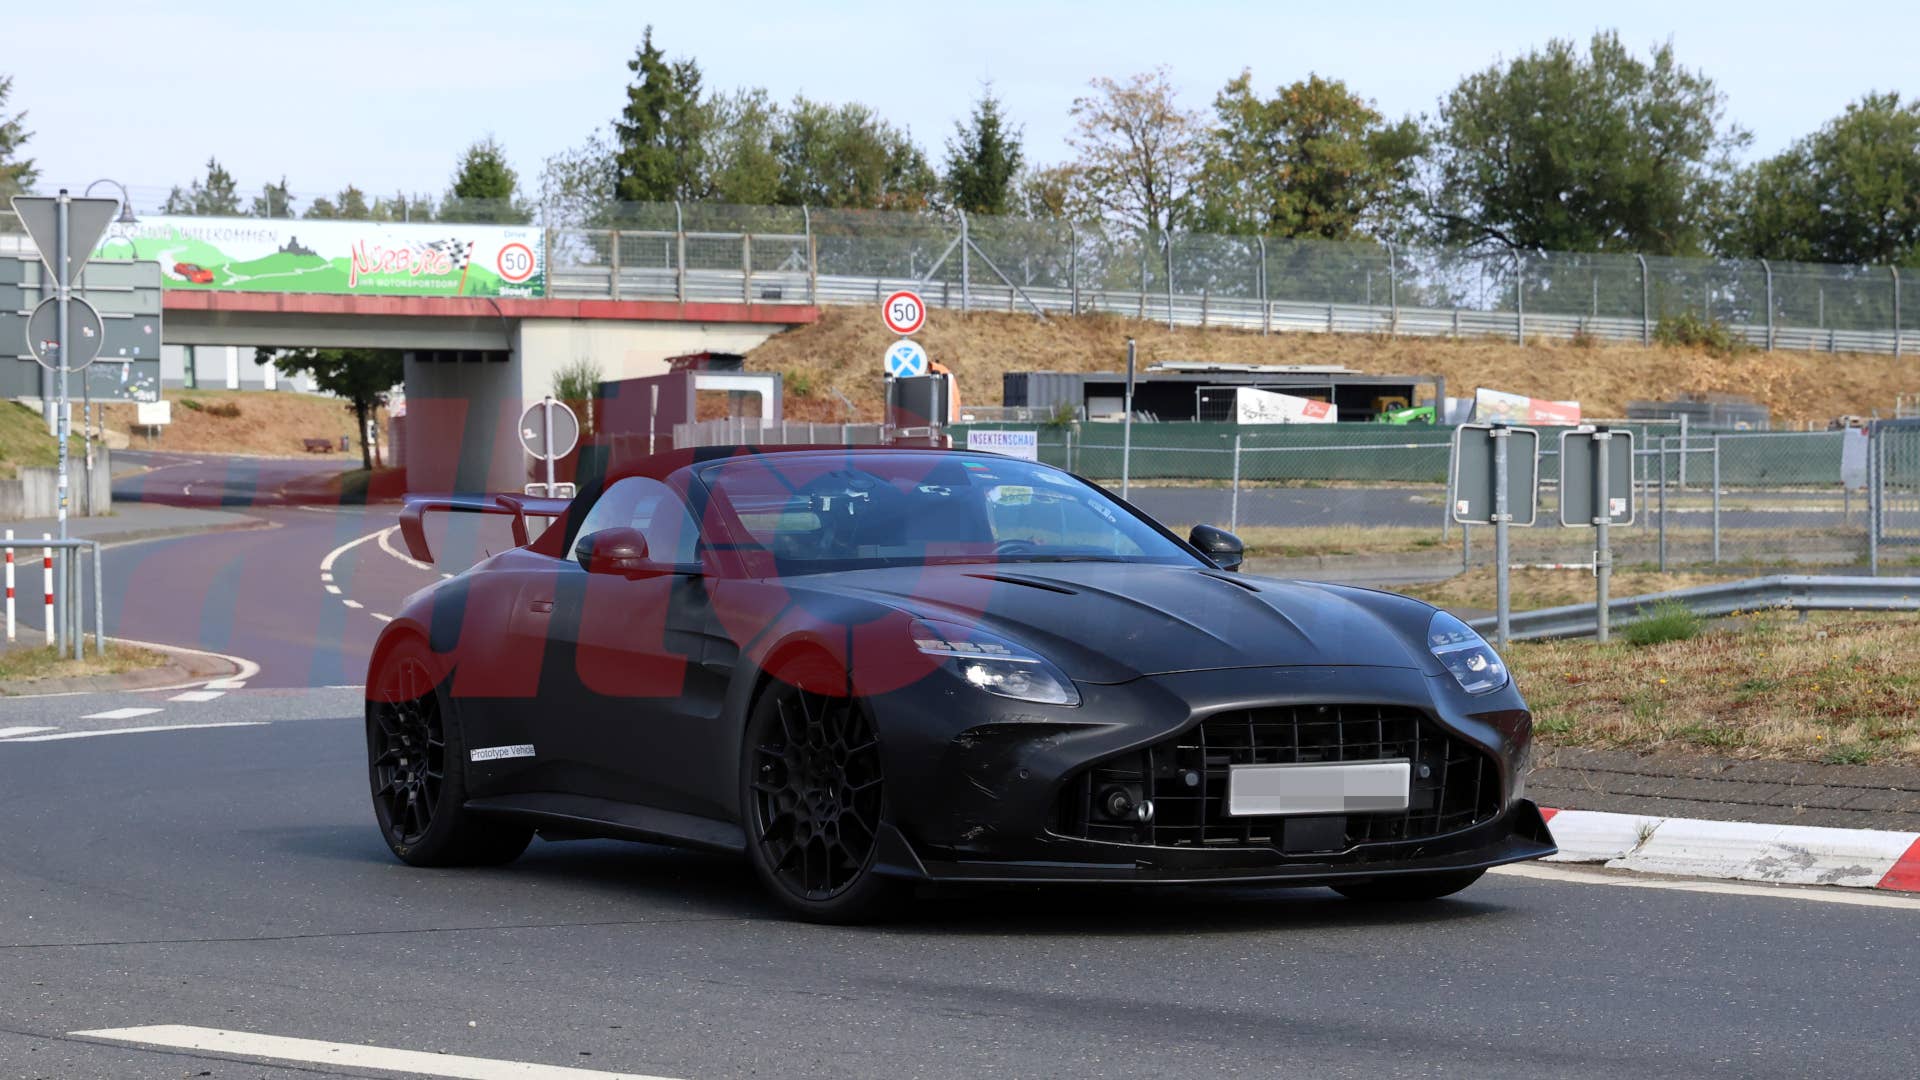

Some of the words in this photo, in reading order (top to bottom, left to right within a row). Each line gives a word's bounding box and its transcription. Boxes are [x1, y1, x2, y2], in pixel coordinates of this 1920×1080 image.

[180, 226, 278, 242] WILLKOMMEN
[349, 238, 452, 288] NÜRBURG
[505, 253, 527, 271] 50
[894, 303, 916, 322] 50
[969, 433, 1034, 446] INSEKTENSCHAU
[471, 748, 509, 759] Prototype
[511, 745, 534, 755] Vehicle
